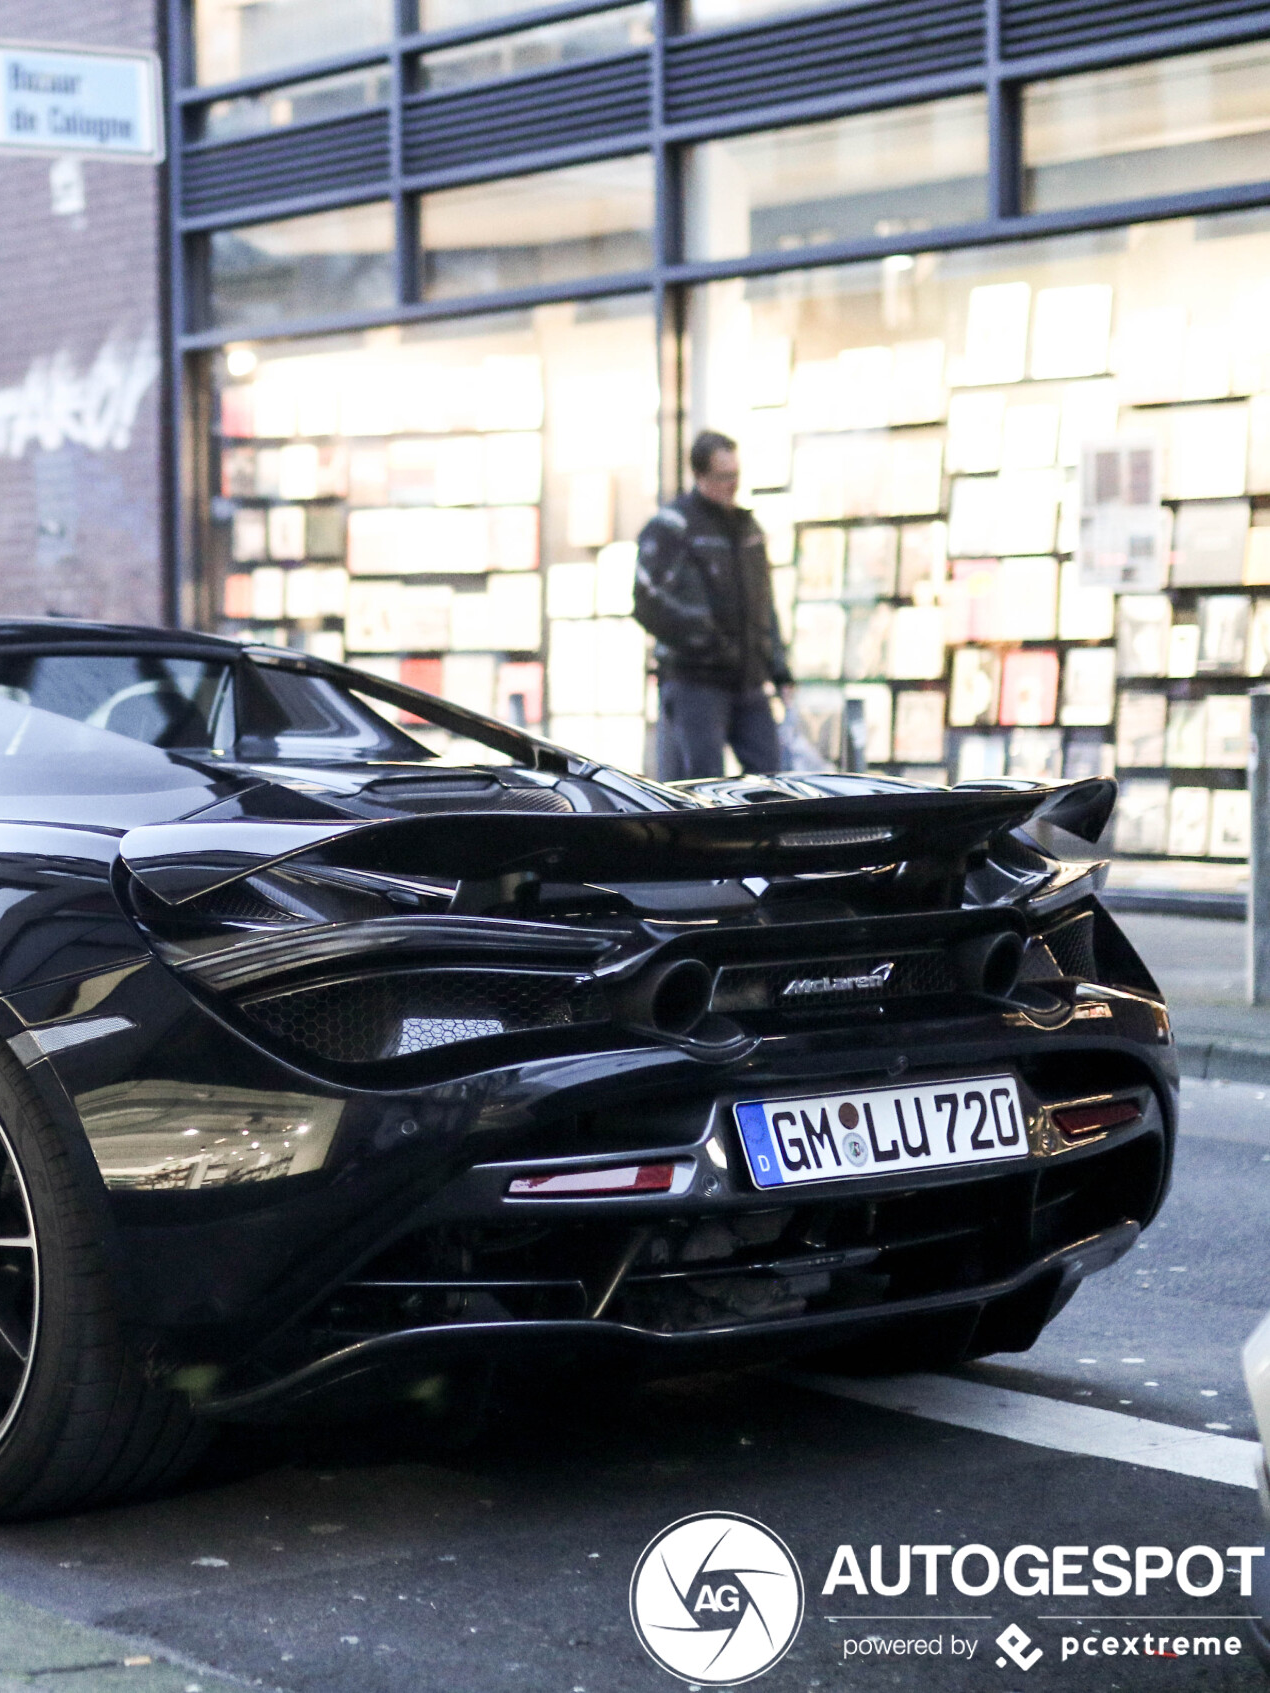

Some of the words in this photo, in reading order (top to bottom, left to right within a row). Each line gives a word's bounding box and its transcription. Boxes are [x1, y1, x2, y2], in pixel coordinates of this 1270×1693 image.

[9, 62, 81, 95] Bazaar
[10, 106, 37, 132] de
[48, 107, 133, 143] Cologne
[782, 973, 885, 995] McLaren
[772, 1107, 841, 1171] GM
[934, 1088, 1020, 1153] 720
[759, 1155, 770, 1172] D
